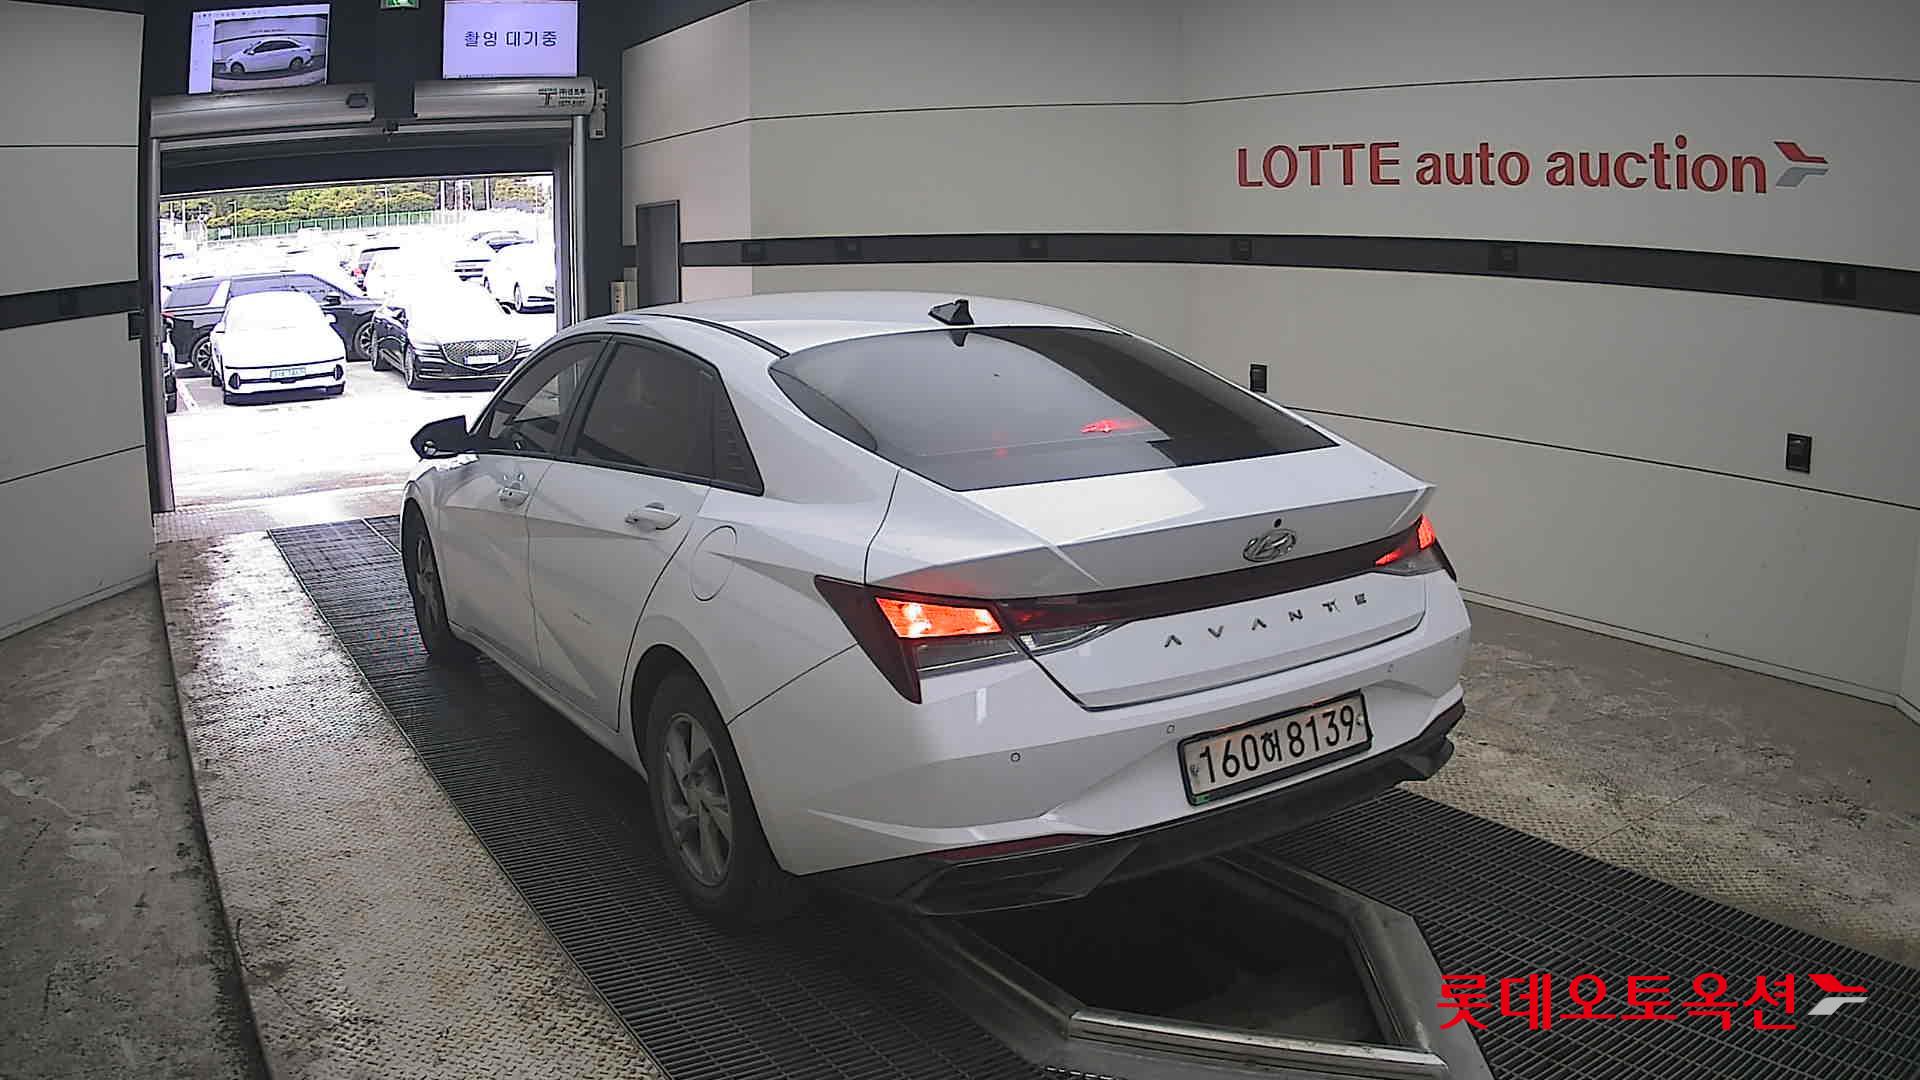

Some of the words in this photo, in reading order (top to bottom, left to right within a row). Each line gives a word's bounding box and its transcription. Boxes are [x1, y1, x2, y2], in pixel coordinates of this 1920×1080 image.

[464, 31, 498, 48] 촬영
[505, 31, 558, 48] 대기중
[1236, 141, 1400, 188] LOTTE
[1415, 142, 1530, 186] auto
[1546, 134, 1767, 193] auction
[1164, 593, 1368, 648] AVANTE
[1199, 705, 1355, 783] 160허8139
